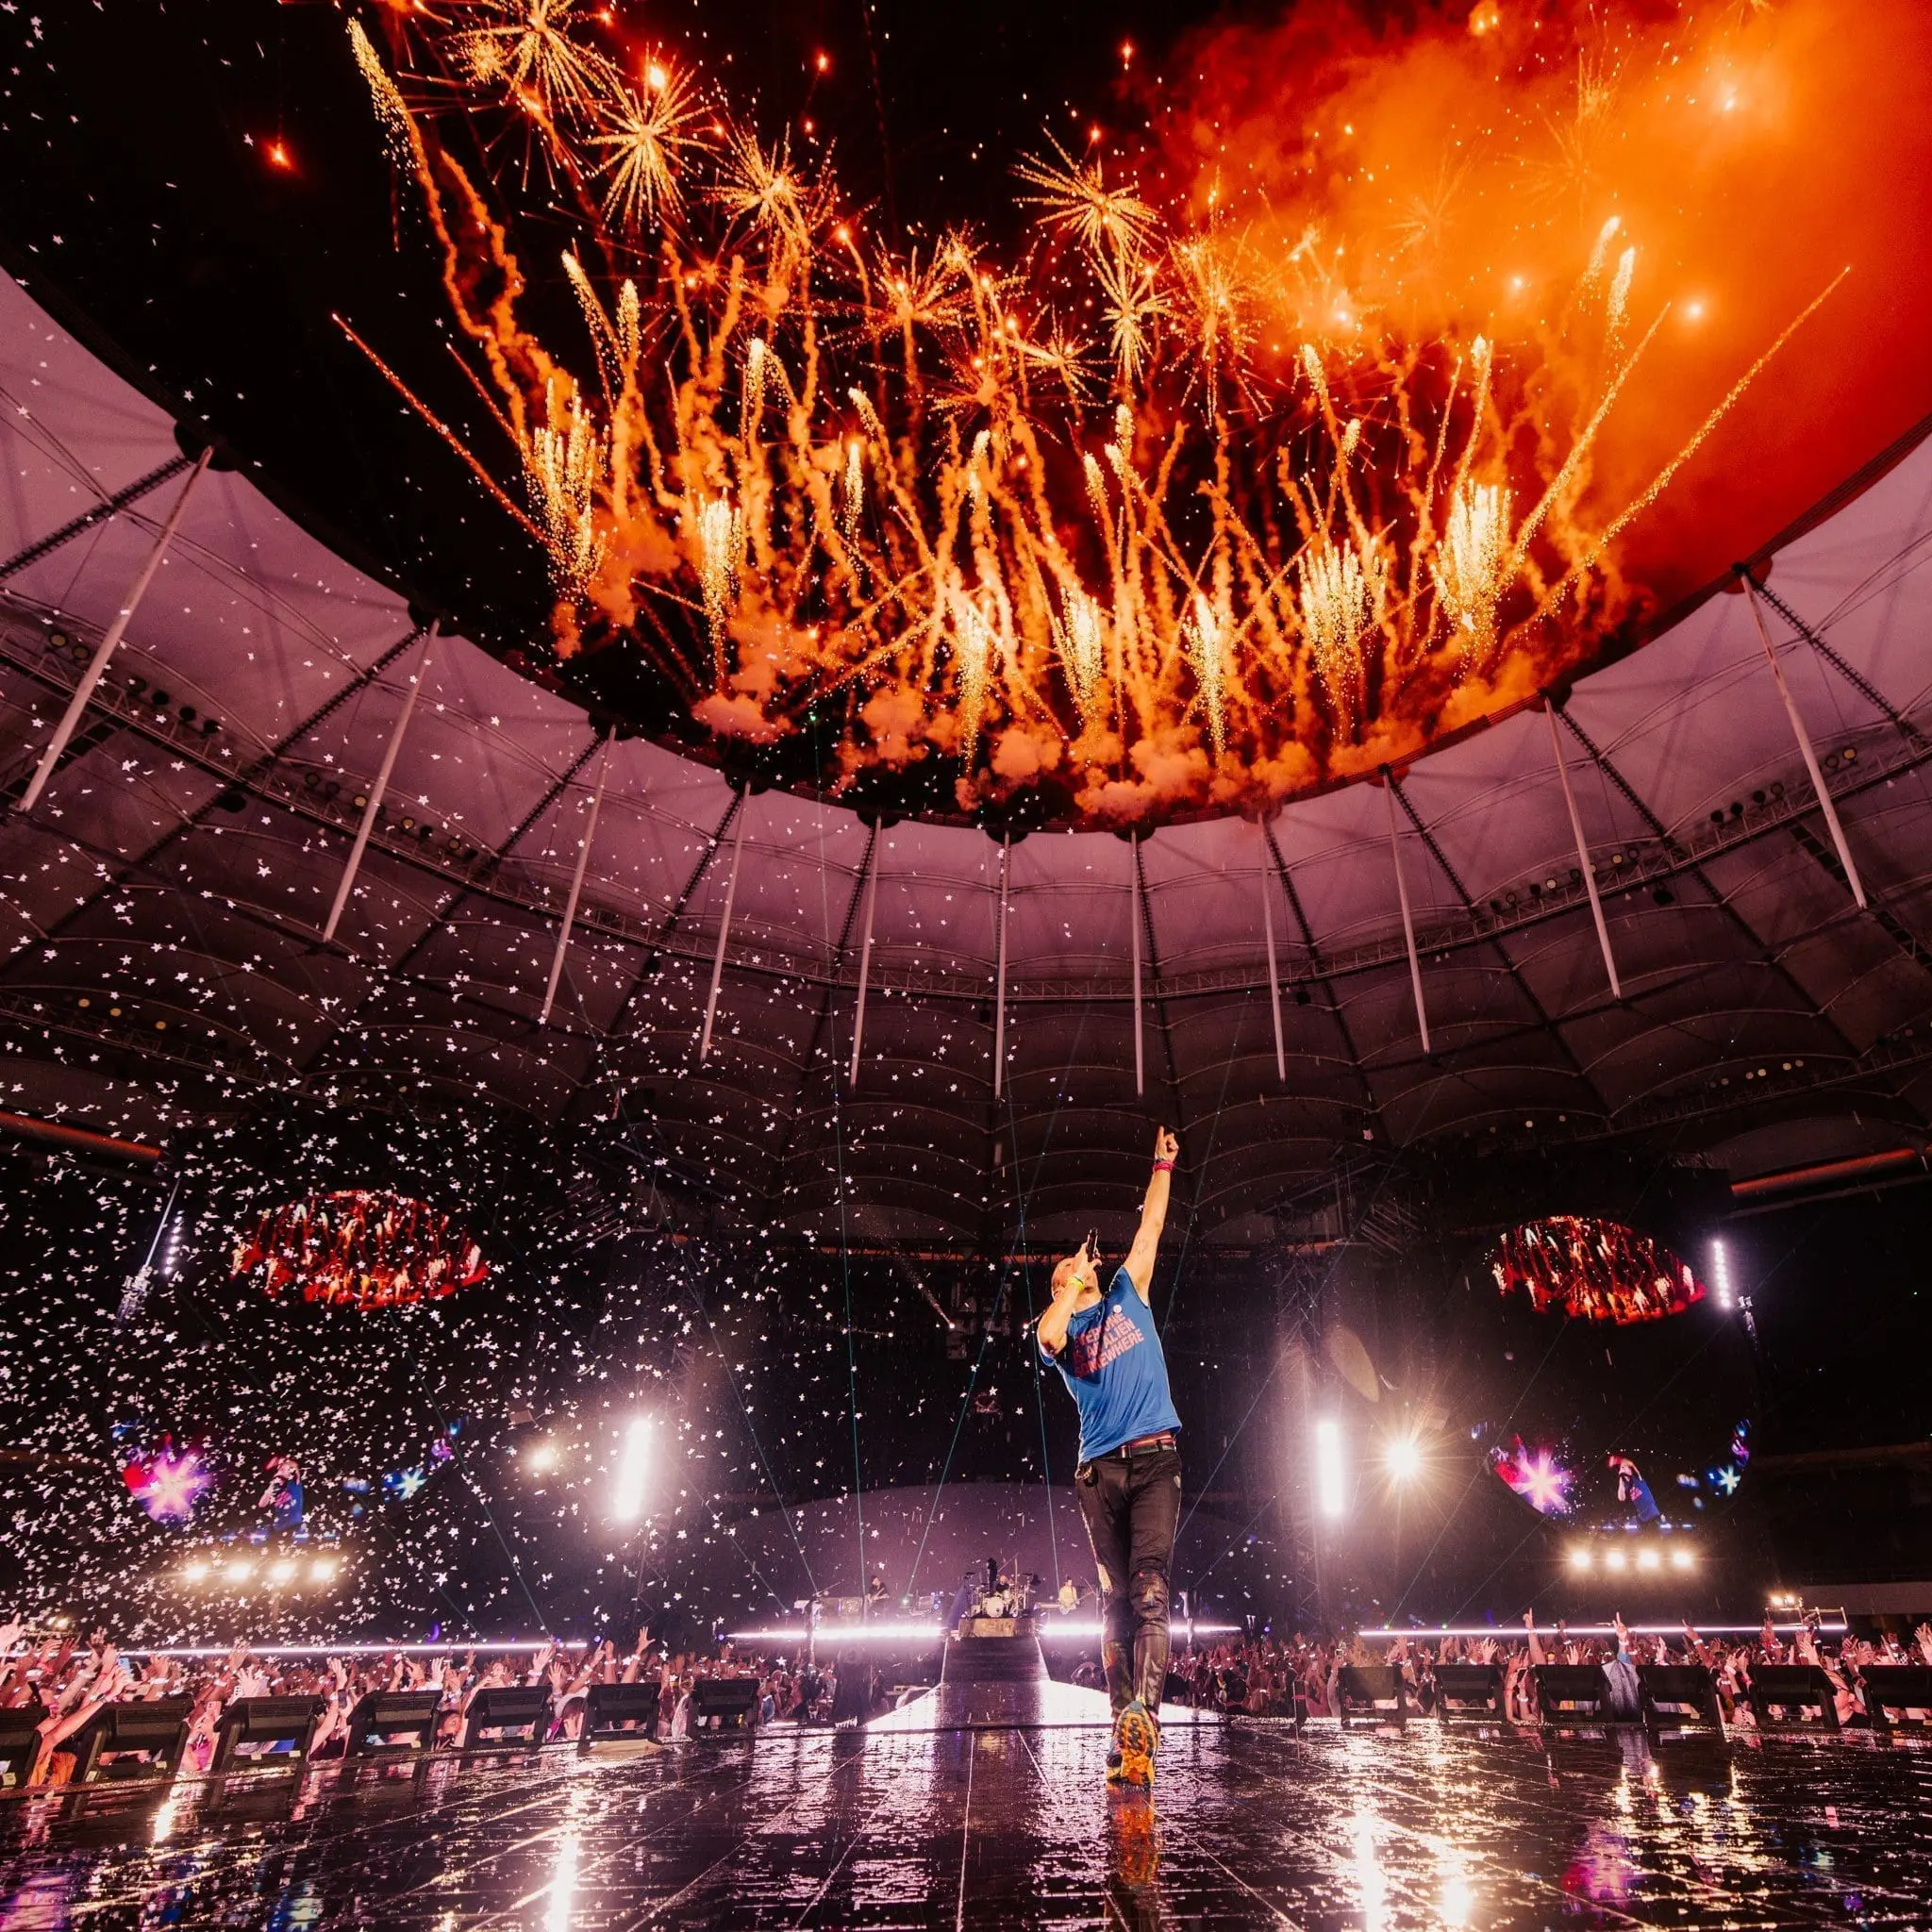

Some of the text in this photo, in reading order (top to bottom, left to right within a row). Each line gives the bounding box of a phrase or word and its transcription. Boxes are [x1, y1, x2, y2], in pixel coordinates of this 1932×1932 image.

[1074, 1312, 1125, 1351] EVERONE
[1103, 1318, 1136, 1349] ALIEN
[1074, 1328, 1144, 1377] SOMEWHERE
